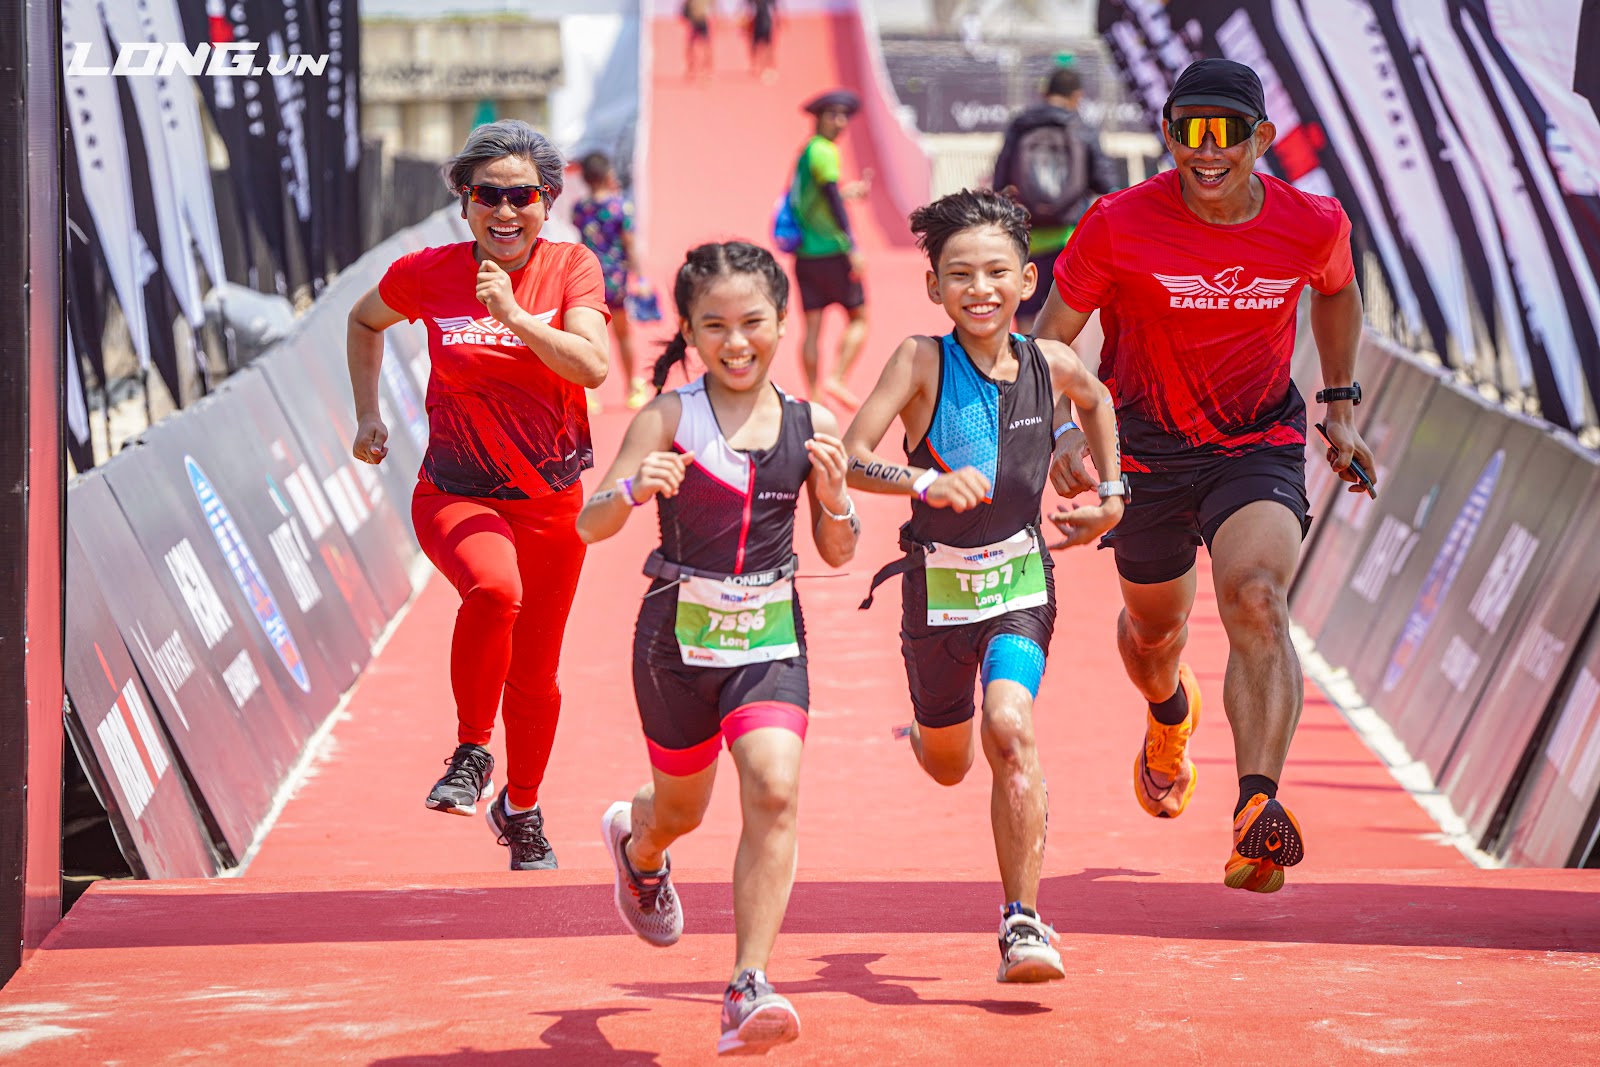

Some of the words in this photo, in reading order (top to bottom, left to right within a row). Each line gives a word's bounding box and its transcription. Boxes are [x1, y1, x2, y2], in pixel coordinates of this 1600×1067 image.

[1170, 296, 1230, 310] EAGLE
[1234, 297, 1285, 310] CAMP
[442, 334, 497, 346] EAGLE
[501, 336, 527, 347] CA
[1009, 416, 1043, 430] APTONIA
[758, 491, 796, 501] APTONIA
[723, 571, 774, 586] AONIJIE
[956, 563, 1014, 593] T597
[975, 593, 1003, 607] Long
[708, 608, 766, 633] T596
[720, 634, 750, 651] Long
[97, 677, 169, 821] IRONAN
